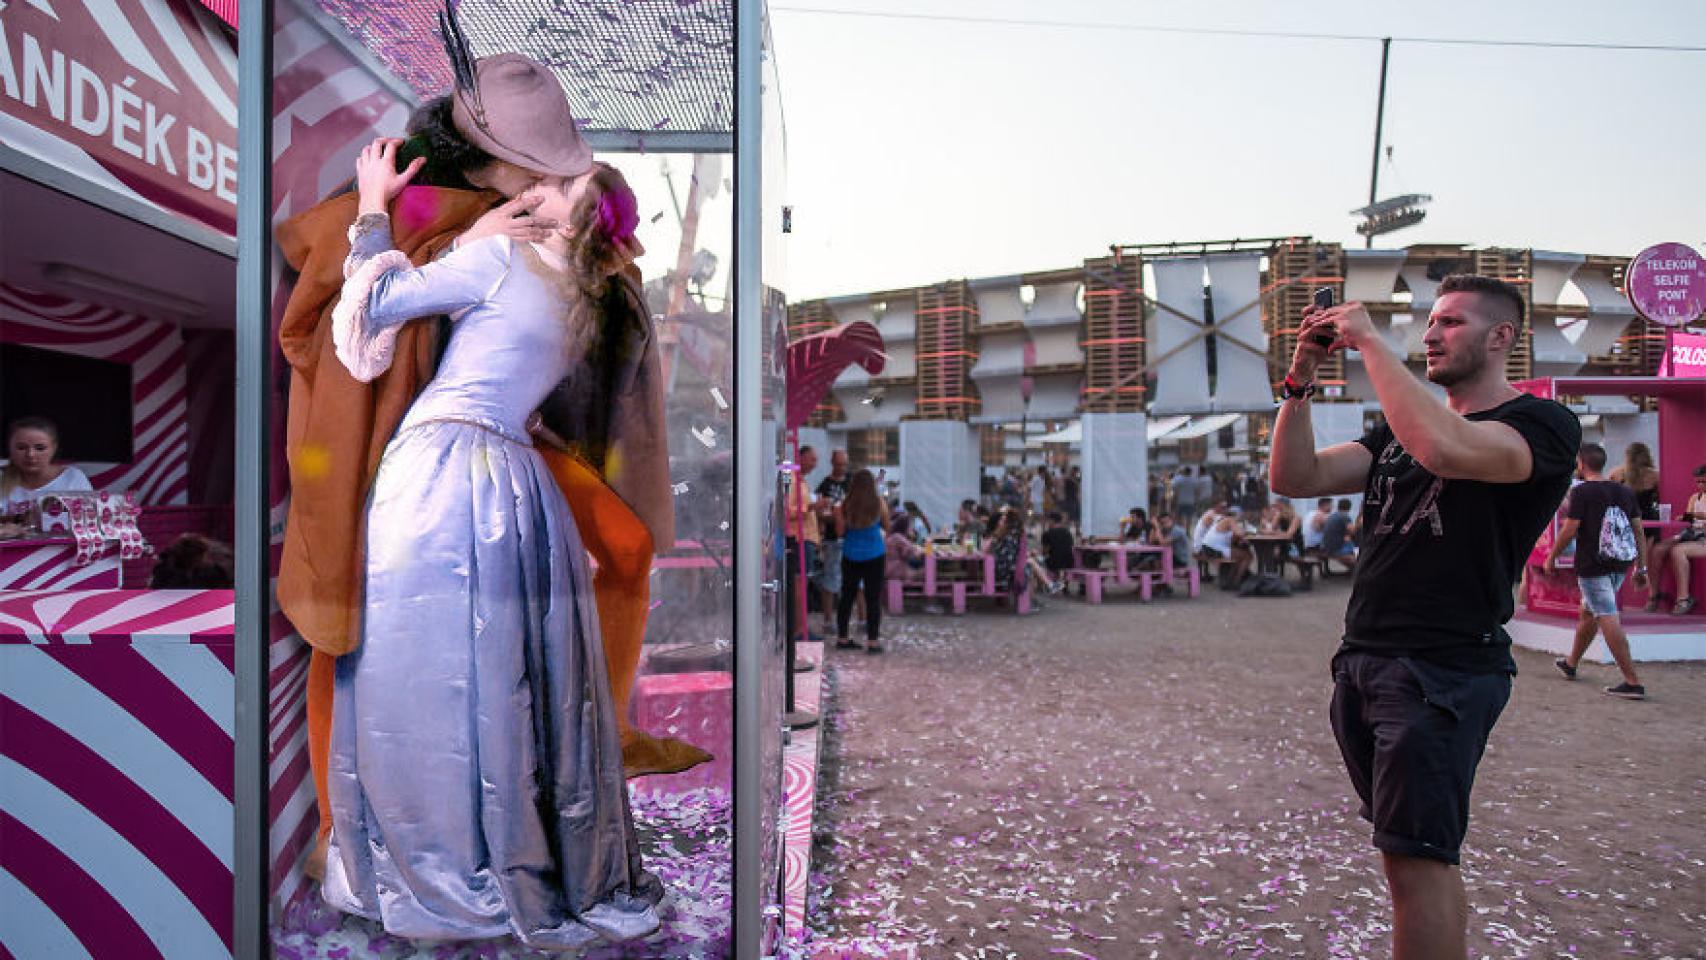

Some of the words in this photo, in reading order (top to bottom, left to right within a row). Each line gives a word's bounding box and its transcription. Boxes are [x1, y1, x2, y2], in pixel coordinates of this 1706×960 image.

[1647, 260, 1697, 271] TELEKOM
[1654, 274, 1690, 286] SELFIE
[1658, 289, 1688, 300] PONT
